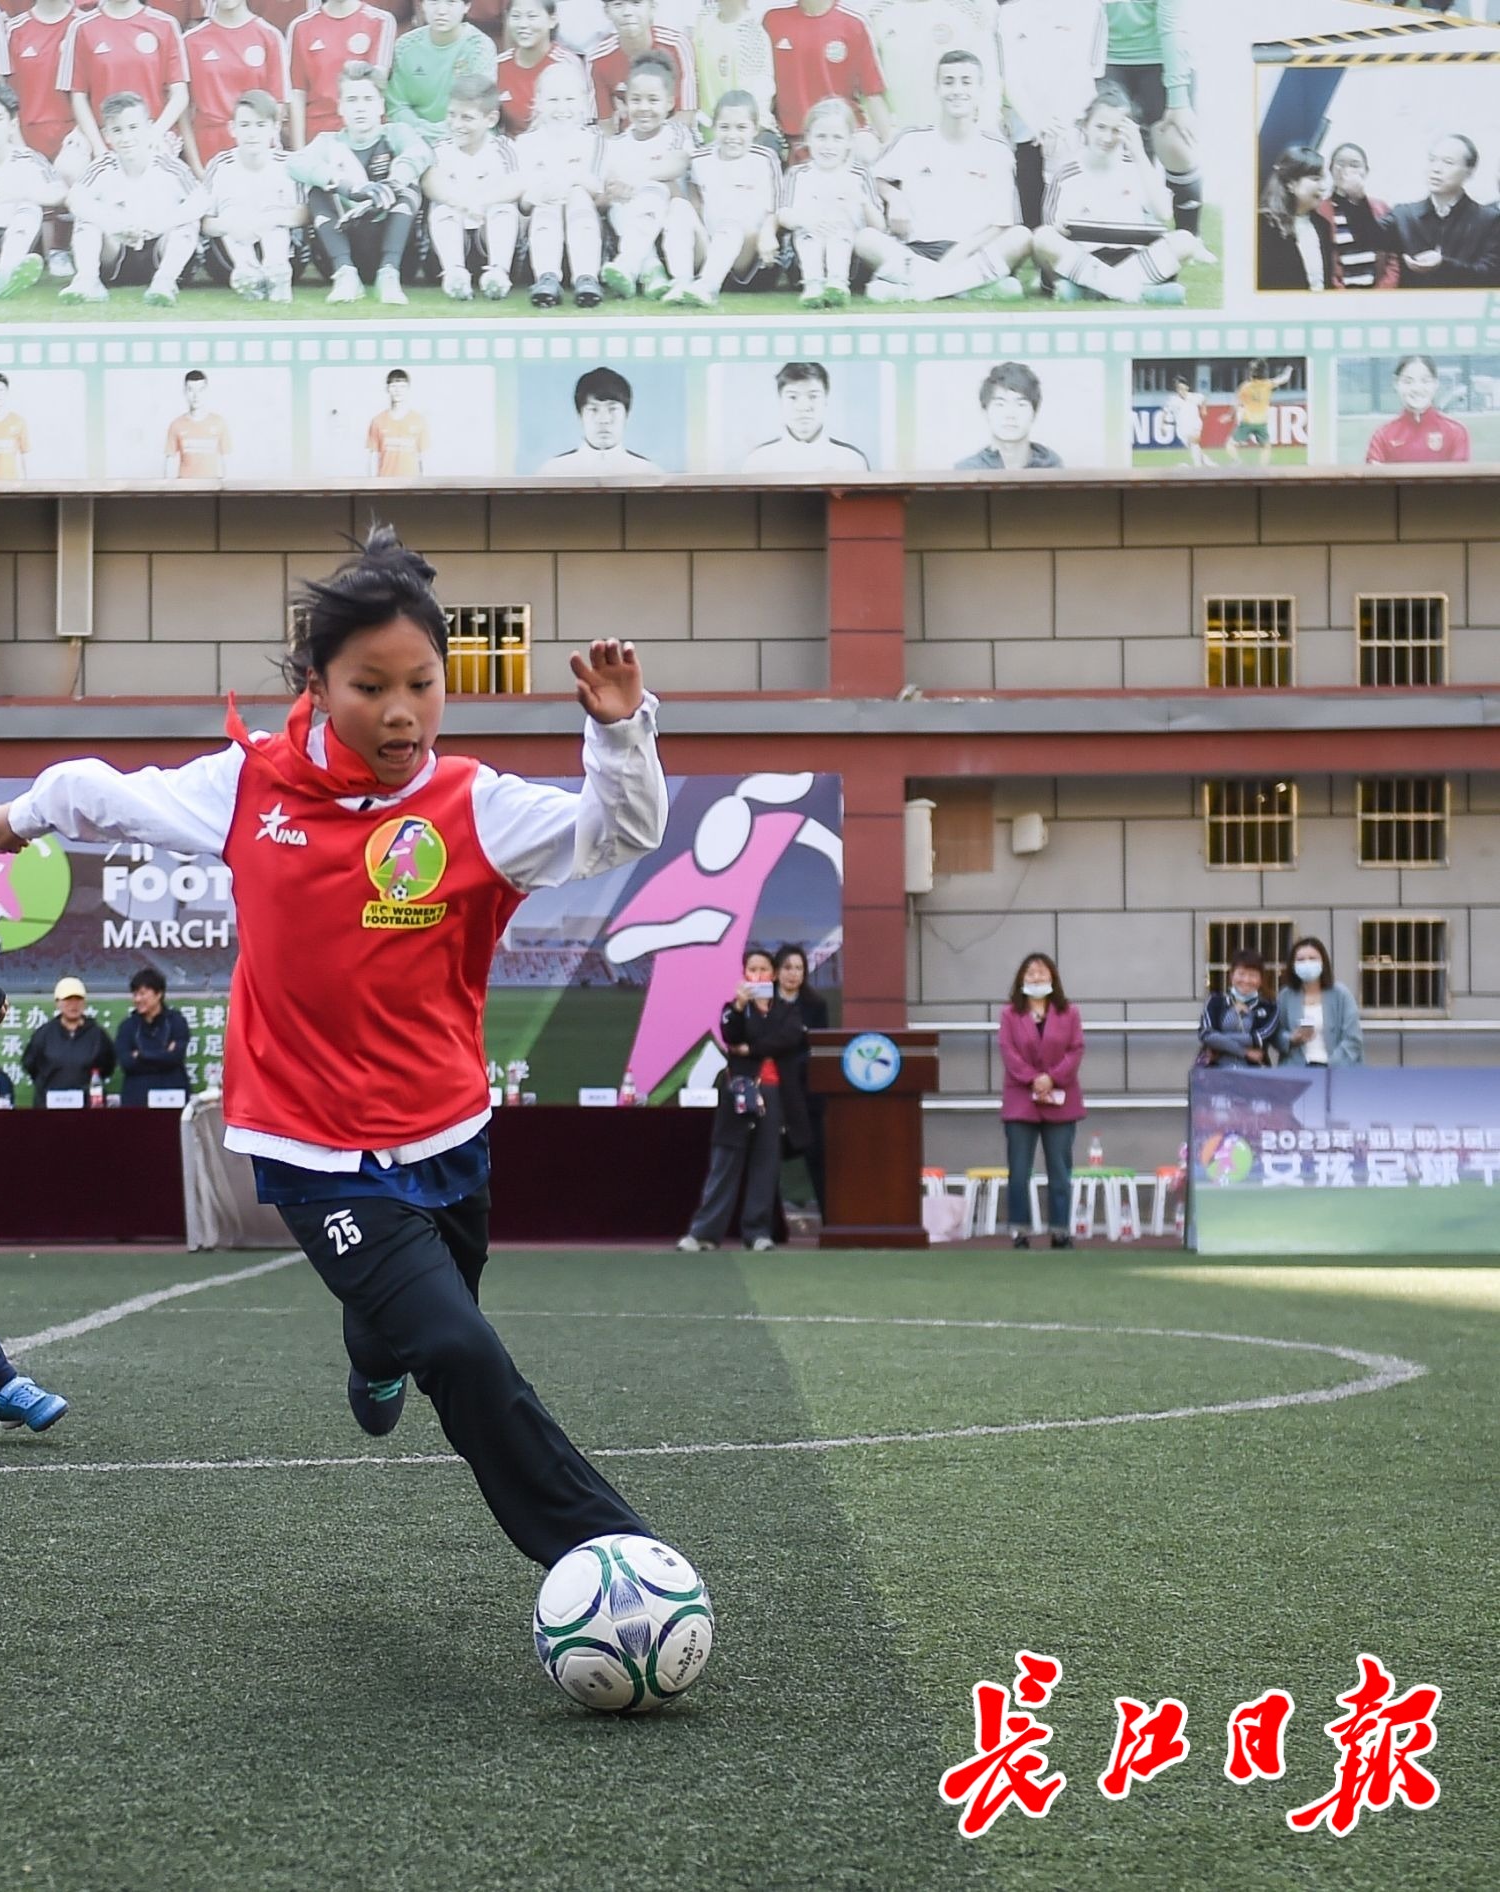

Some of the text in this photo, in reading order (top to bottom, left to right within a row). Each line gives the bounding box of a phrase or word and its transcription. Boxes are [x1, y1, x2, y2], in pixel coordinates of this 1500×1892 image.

[102, 919, 230, 949] MARCH
[365, 914, 421, 926] FOOTBALL
[327, 1215, 363, 1256] 25
